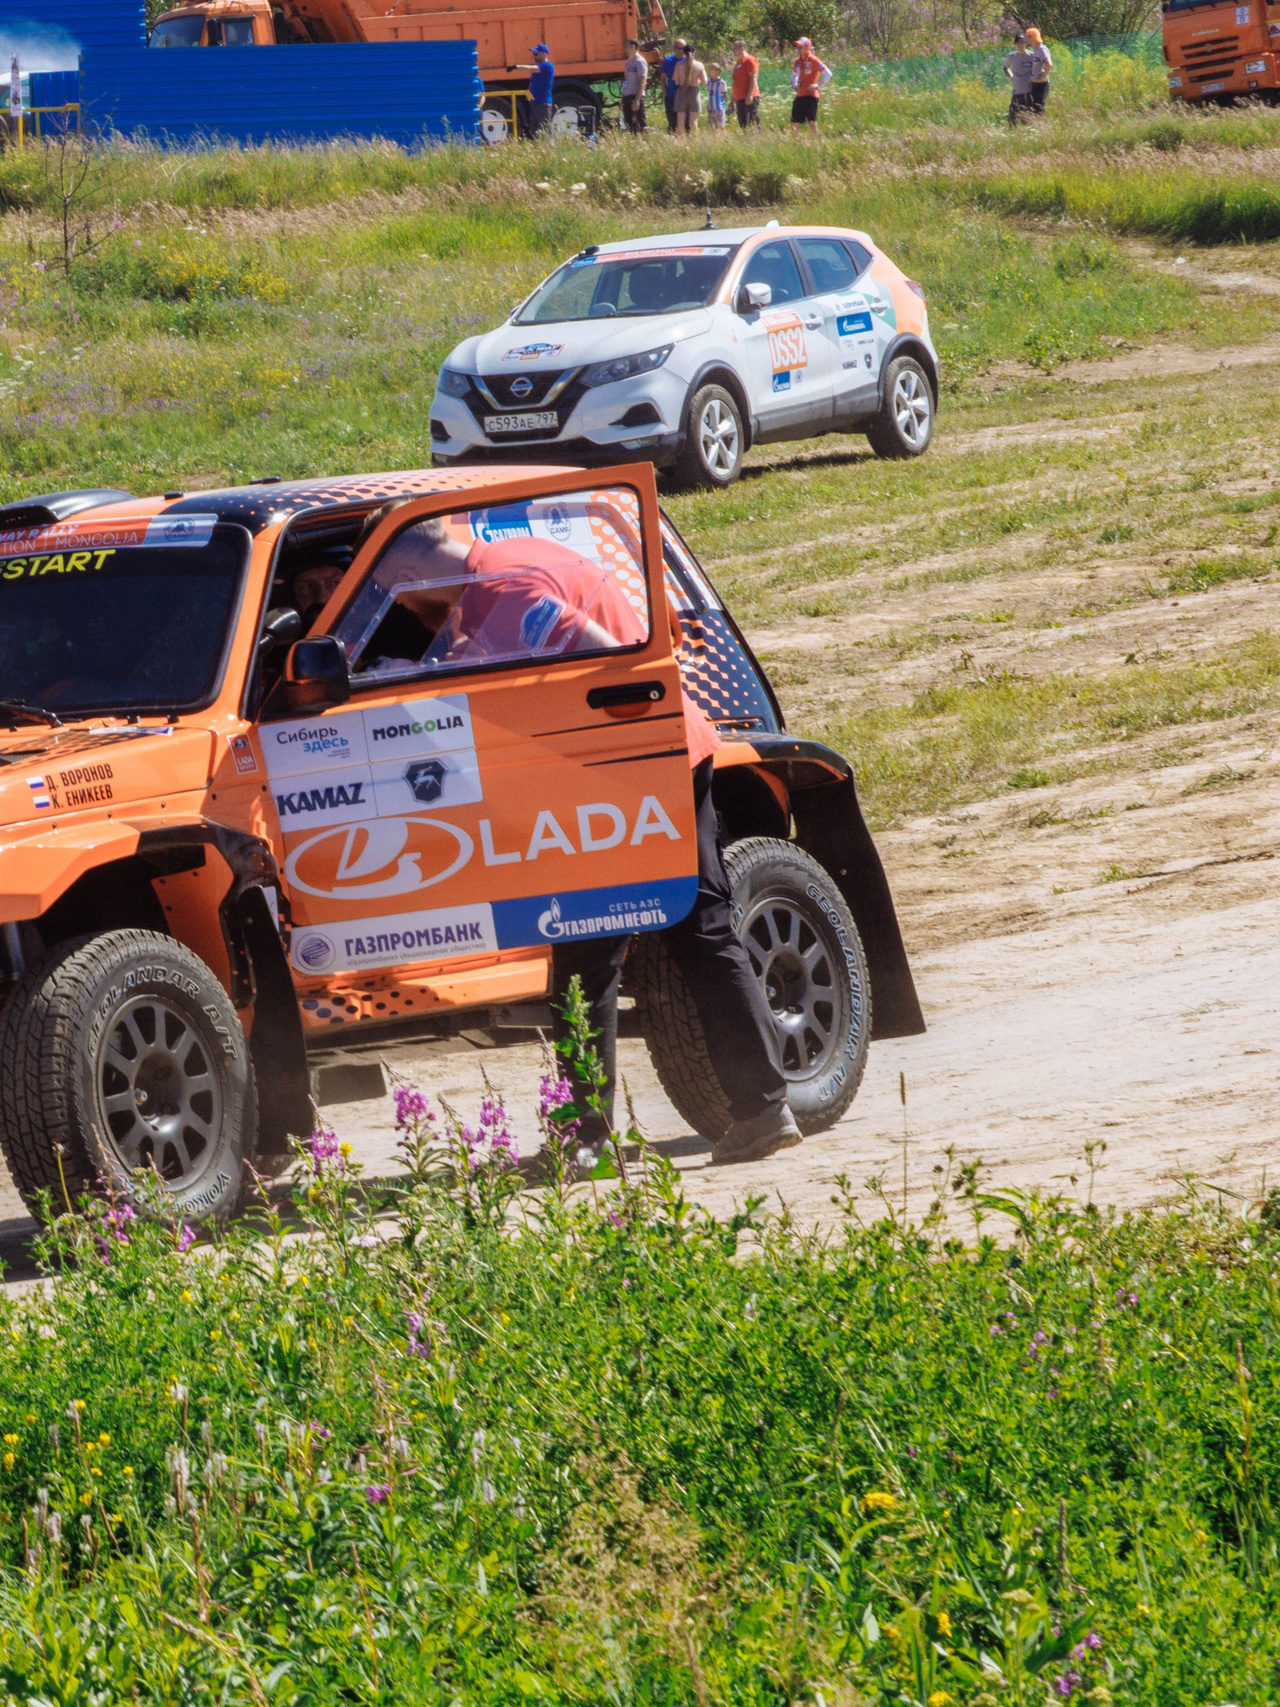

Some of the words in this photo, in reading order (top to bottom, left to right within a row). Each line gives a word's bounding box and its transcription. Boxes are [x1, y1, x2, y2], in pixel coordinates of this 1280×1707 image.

[768, 326, 807, 369] DSS2
[536, 413, 555, 423] 797
[27, 524, 80, 539] RALLY
[55, 532, 139, 549] MONGOLIA
[276, 724, 339, 745] Сибирь
[372, 715, 465, 741] MONGOLIA
[303, 736, 349, 753] здесь
[45, 774, 59, 793] Д.
[59, 763, 114, 787] ВОРОНОВ
[51, 793, 64, 810] К.
[65, 783, 113, 807] ЕНИКЕЕВ
[276, 782, 366, 817] KAMAZ
[478, 795, 682, 867] LADA
[609, 901, 637, 913] СЕТЬ
[639, 897, 661, 908] АЗС
[564, 908, 668, 936] ГАЗПРОМНЕФТЬ
[344, 921, 484, 957] ГАЗПРОМБАНК
[806, 882, 863, 1061] GEOLANDAR
[87, 965, 201, 1058] GEOLANDAR
